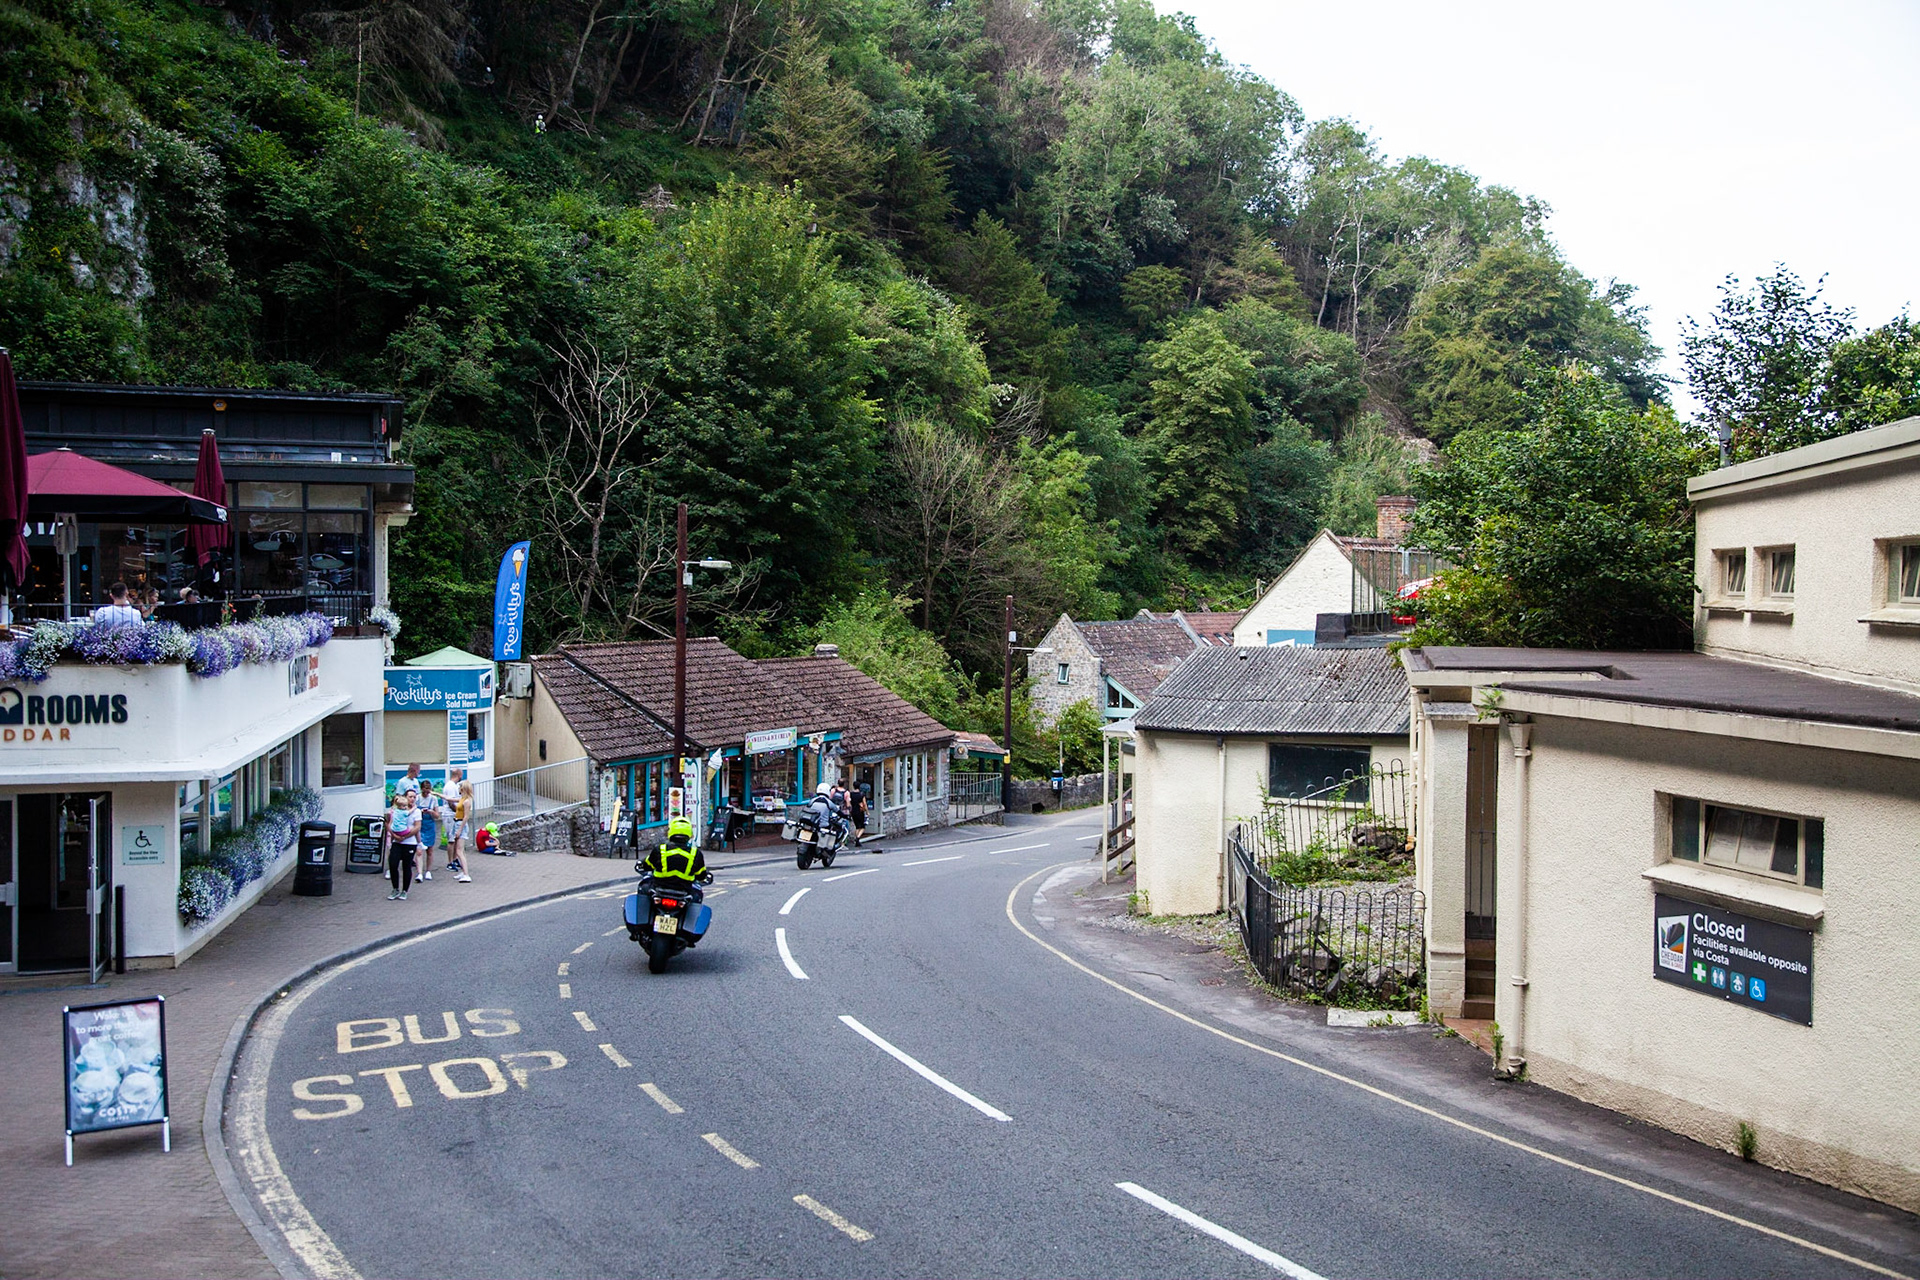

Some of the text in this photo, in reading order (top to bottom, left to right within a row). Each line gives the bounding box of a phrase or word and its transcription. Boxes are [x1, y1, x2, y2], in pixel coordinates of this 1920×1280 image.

[503, 582, 522, 656] Roskilly's
[27, 694, 128, 725] ROOMS
[387, 686, 442, 706] Roskilly's
[1692, 912, 1745, 942] Closed
[1692, 934, 1808, 974] Facilities available opposite
[1692, 947, 1730, 966] via Costa
[88, 1024, 112, 1033] more
[93, 1011, 120, 1021] Wake
[336, 1008, 521, 1054] BUS
[292, 1050, 568, 1120] STOP
[98, 1104, 138, 1118] COSTA
